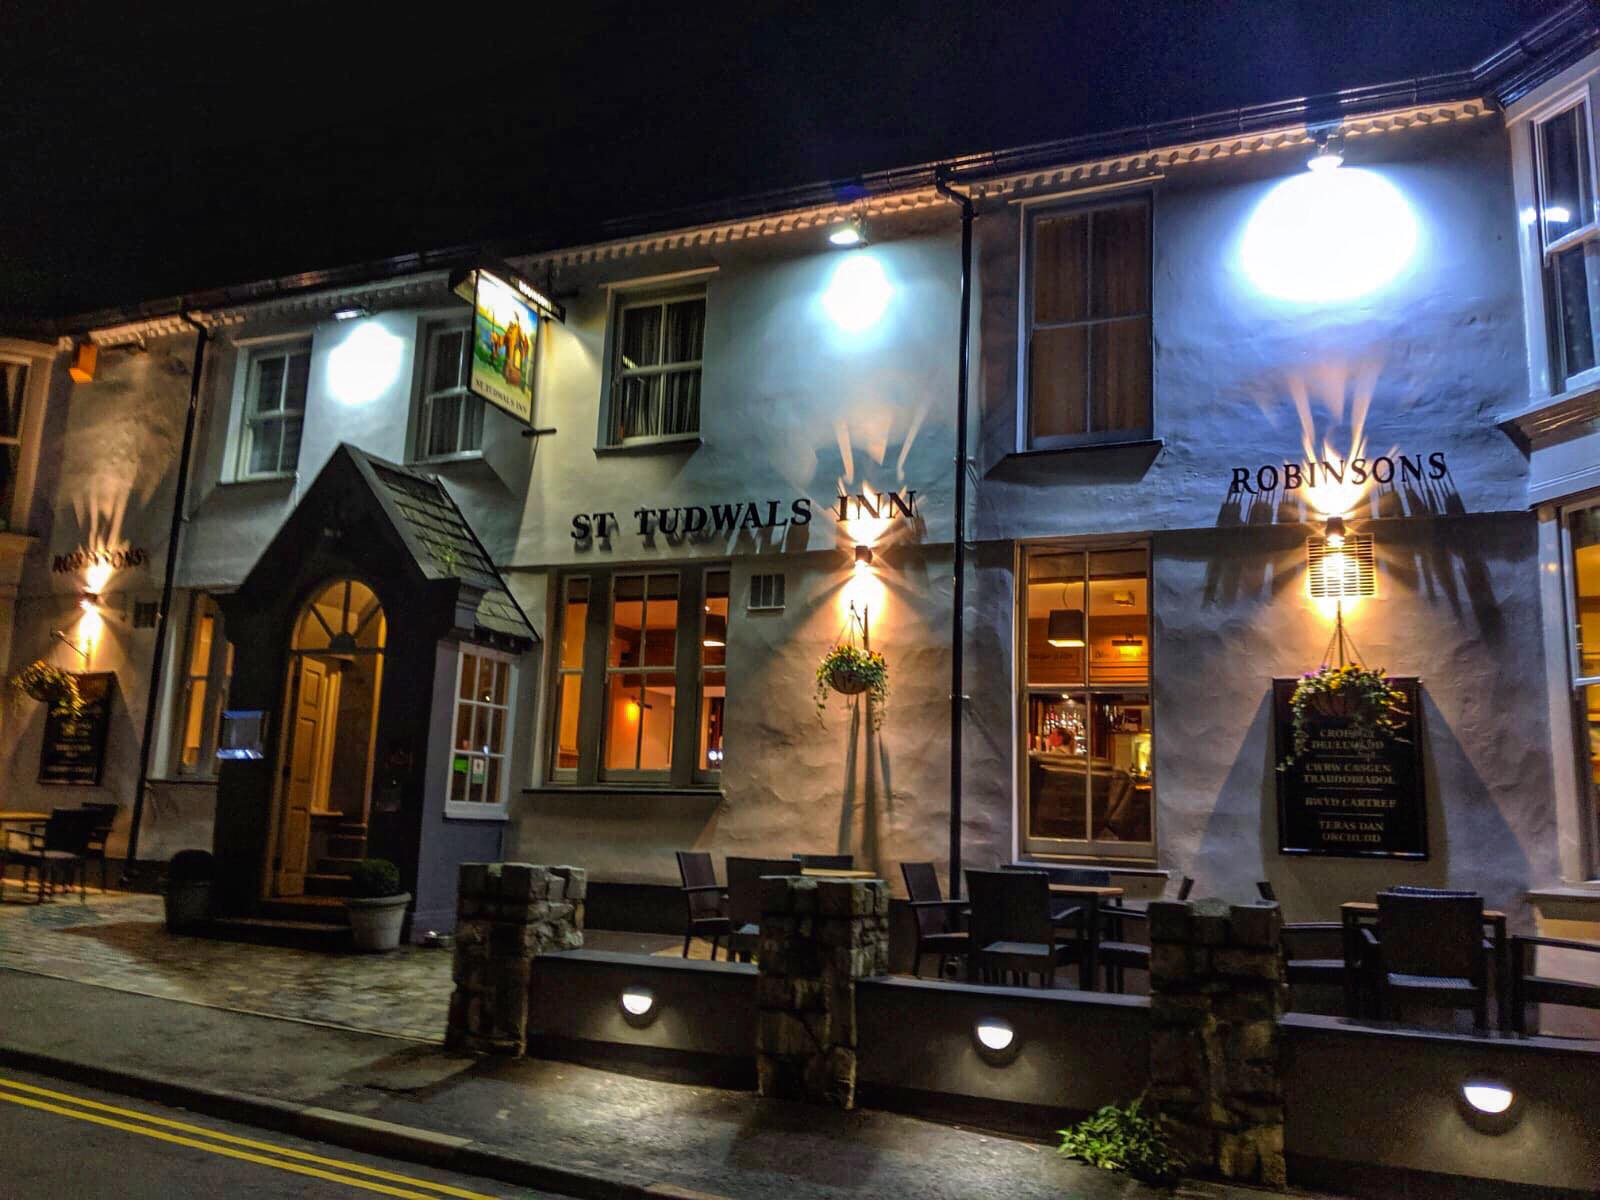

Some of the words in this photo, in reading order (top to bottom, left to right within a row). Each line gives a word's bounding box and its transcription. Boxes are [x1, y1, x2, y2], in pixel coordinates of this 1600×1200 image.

[1231, 452, 1448, 495] ROBINSONS
[570, 511, 616, 539] ST
[634, 498, 812, 536] TUDWALS
[836, 490, 916, 522] INN
[1319, 728, 1368, 738] CROE
[1304, 797, 1340, 806] BWYD
[1319, 820, 1357, 830] TERAS
[1359, 822, 1385, 831] DAN
